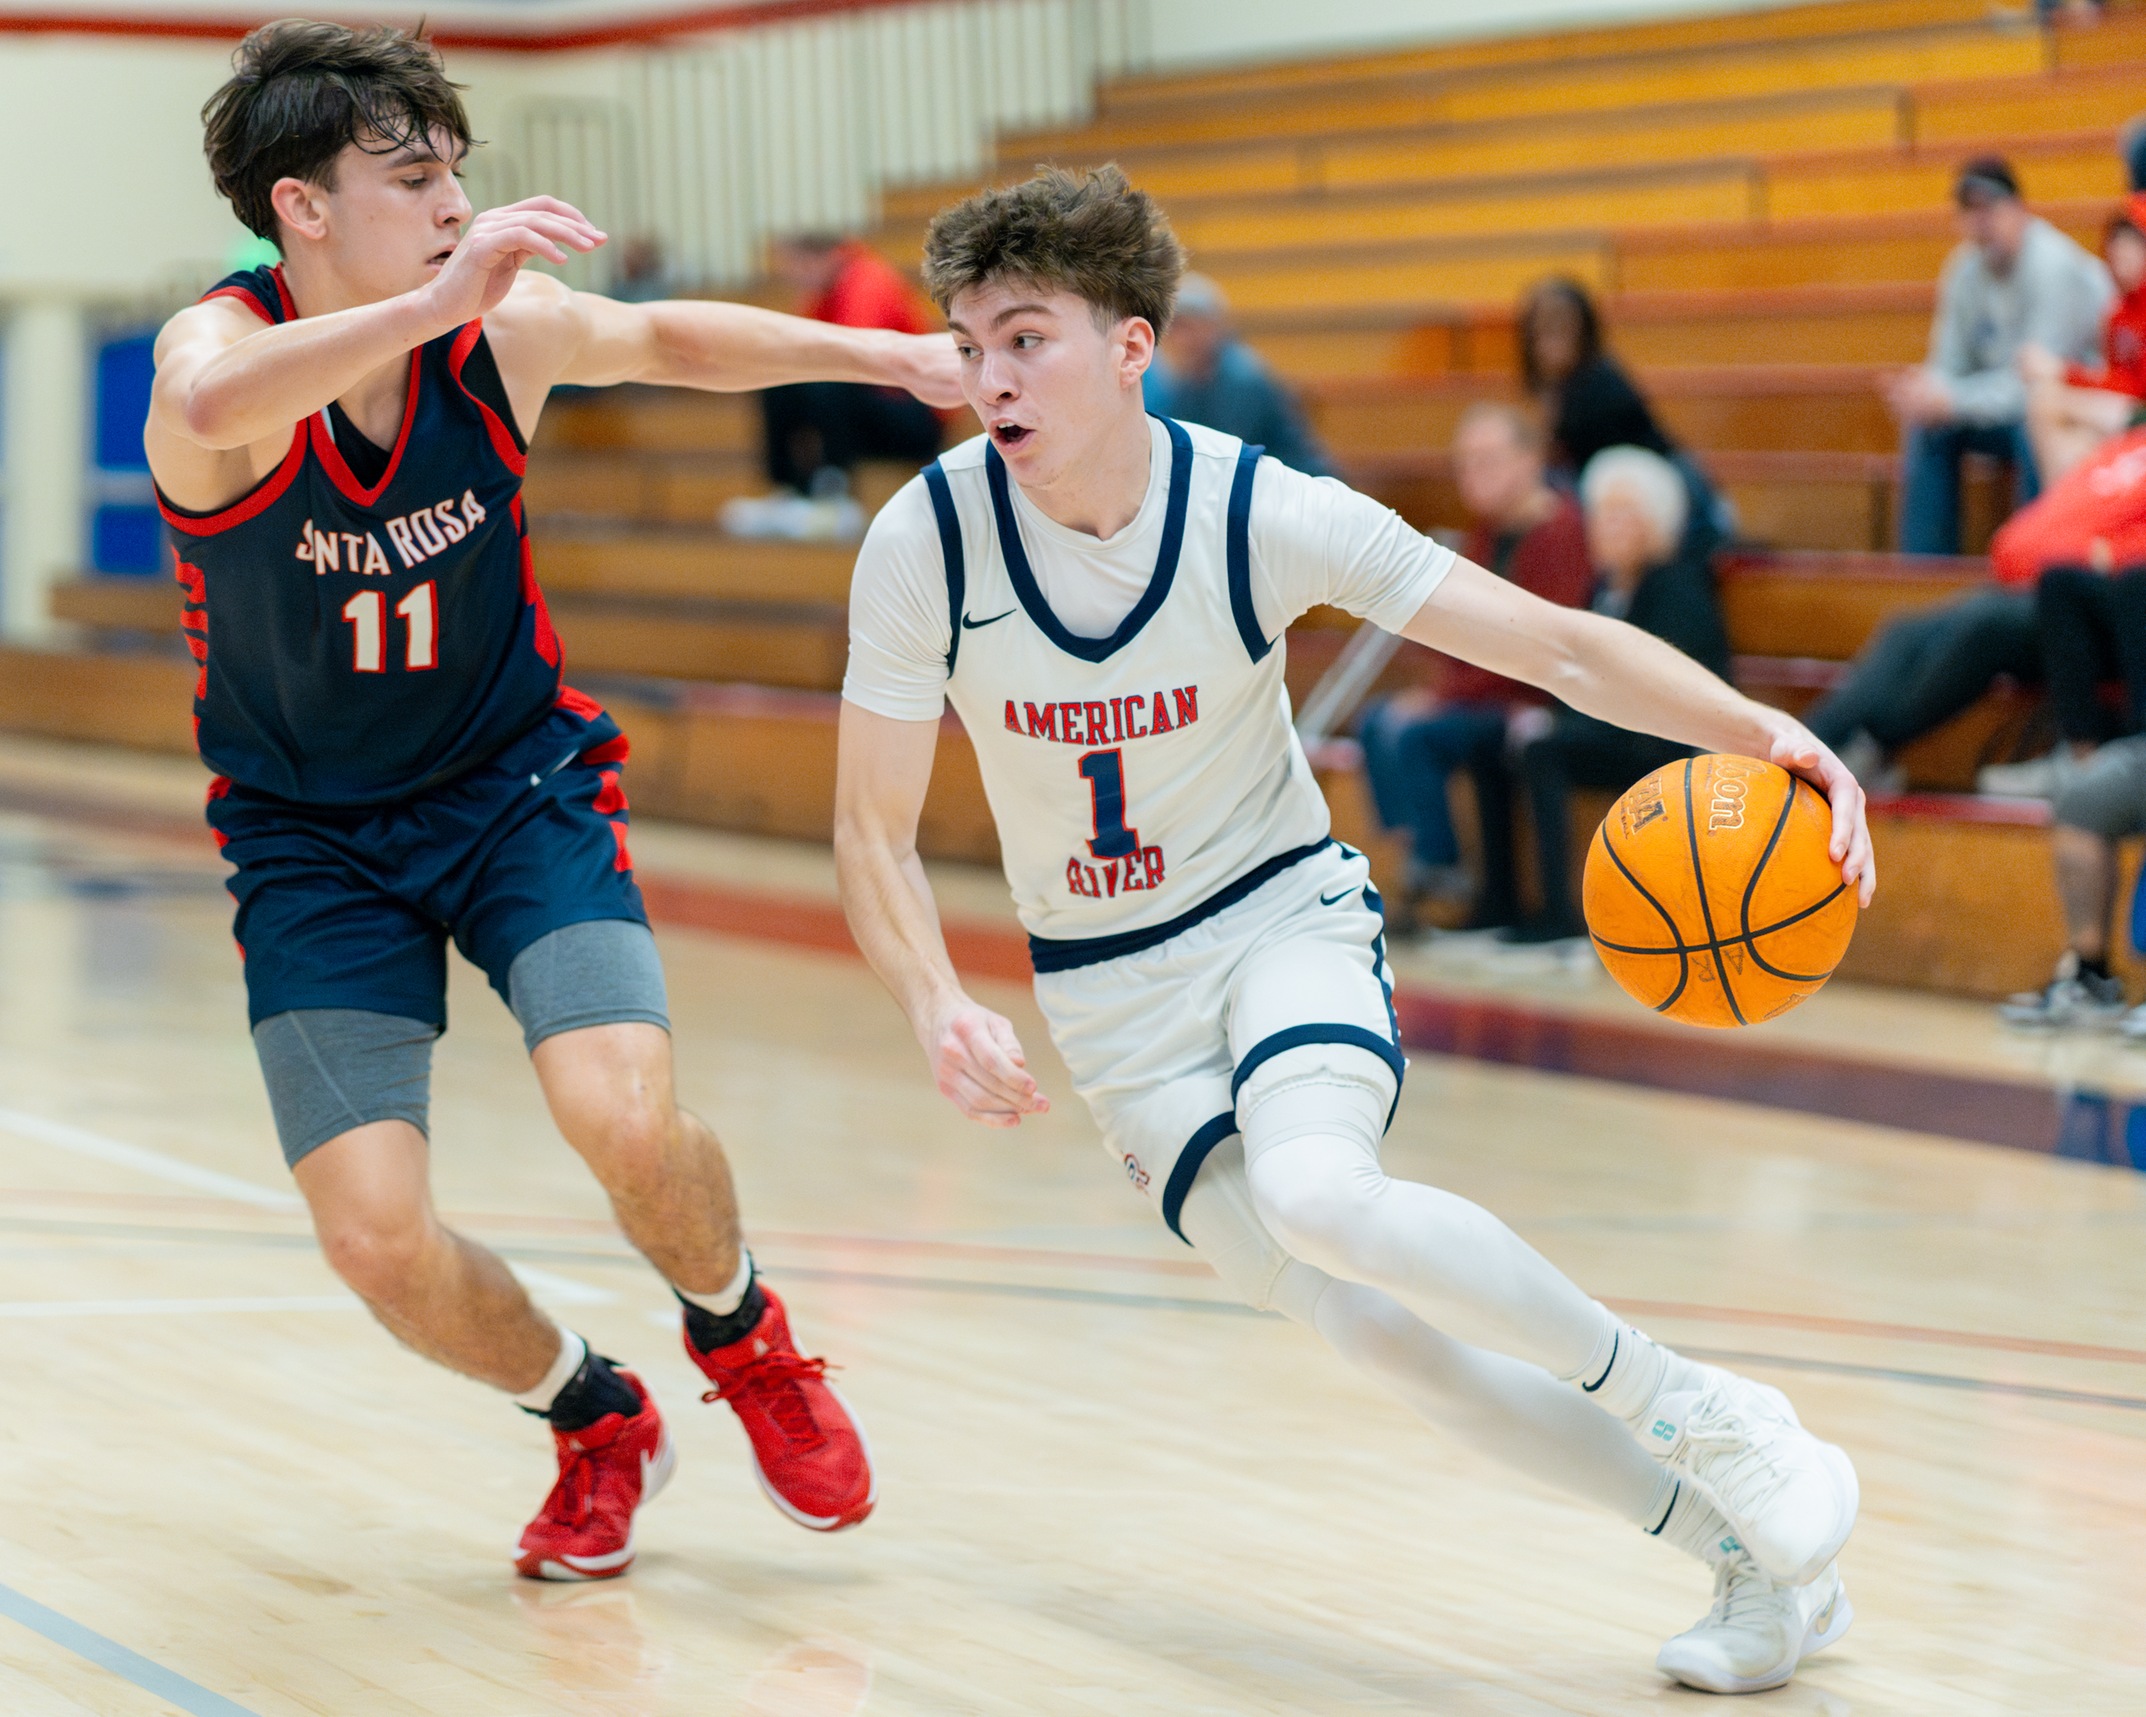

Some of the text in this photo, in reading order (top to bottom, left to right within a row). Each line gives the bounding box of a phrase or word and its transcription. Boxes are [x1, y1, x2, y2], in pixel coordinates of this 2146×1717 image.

[295, 488, 487, 576] SNTA ROSA
[341, 579, 439, 674] 11
[1004, 685, 1199, 746] AMERICAN
[1077, 747, 1141, 861] 1
[1066, 845, 1166, 899] RIVER
